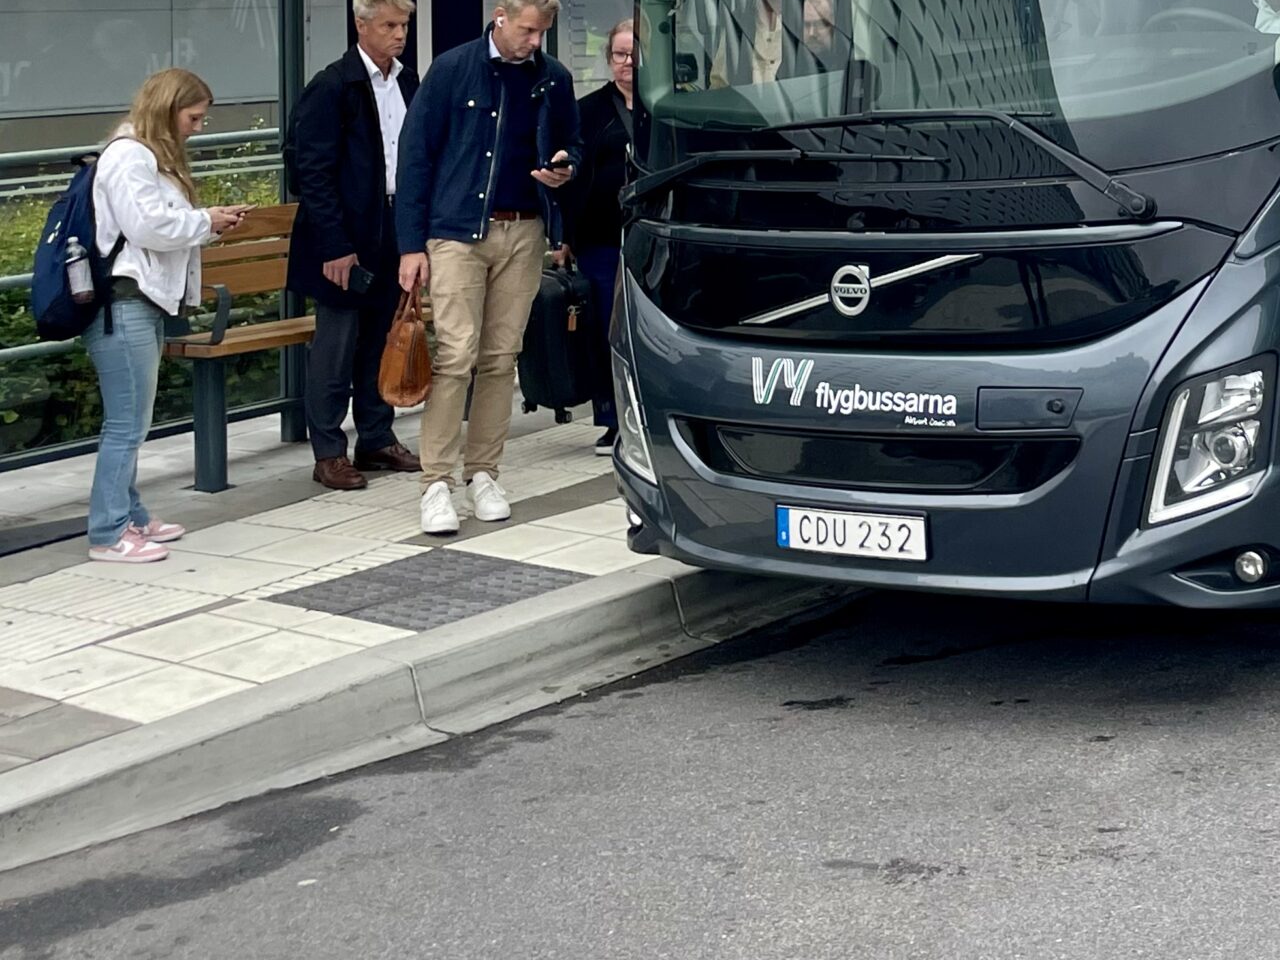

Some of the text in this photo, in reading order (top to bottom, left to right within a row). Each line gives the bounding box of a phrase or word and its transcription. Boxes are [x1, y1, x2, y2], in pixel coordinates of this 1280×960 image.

[833, 286, 868, 295] VOLVO
[815, 382, 957, 416] flygbussarna
[799, 515, 913, 554] CDU 232
